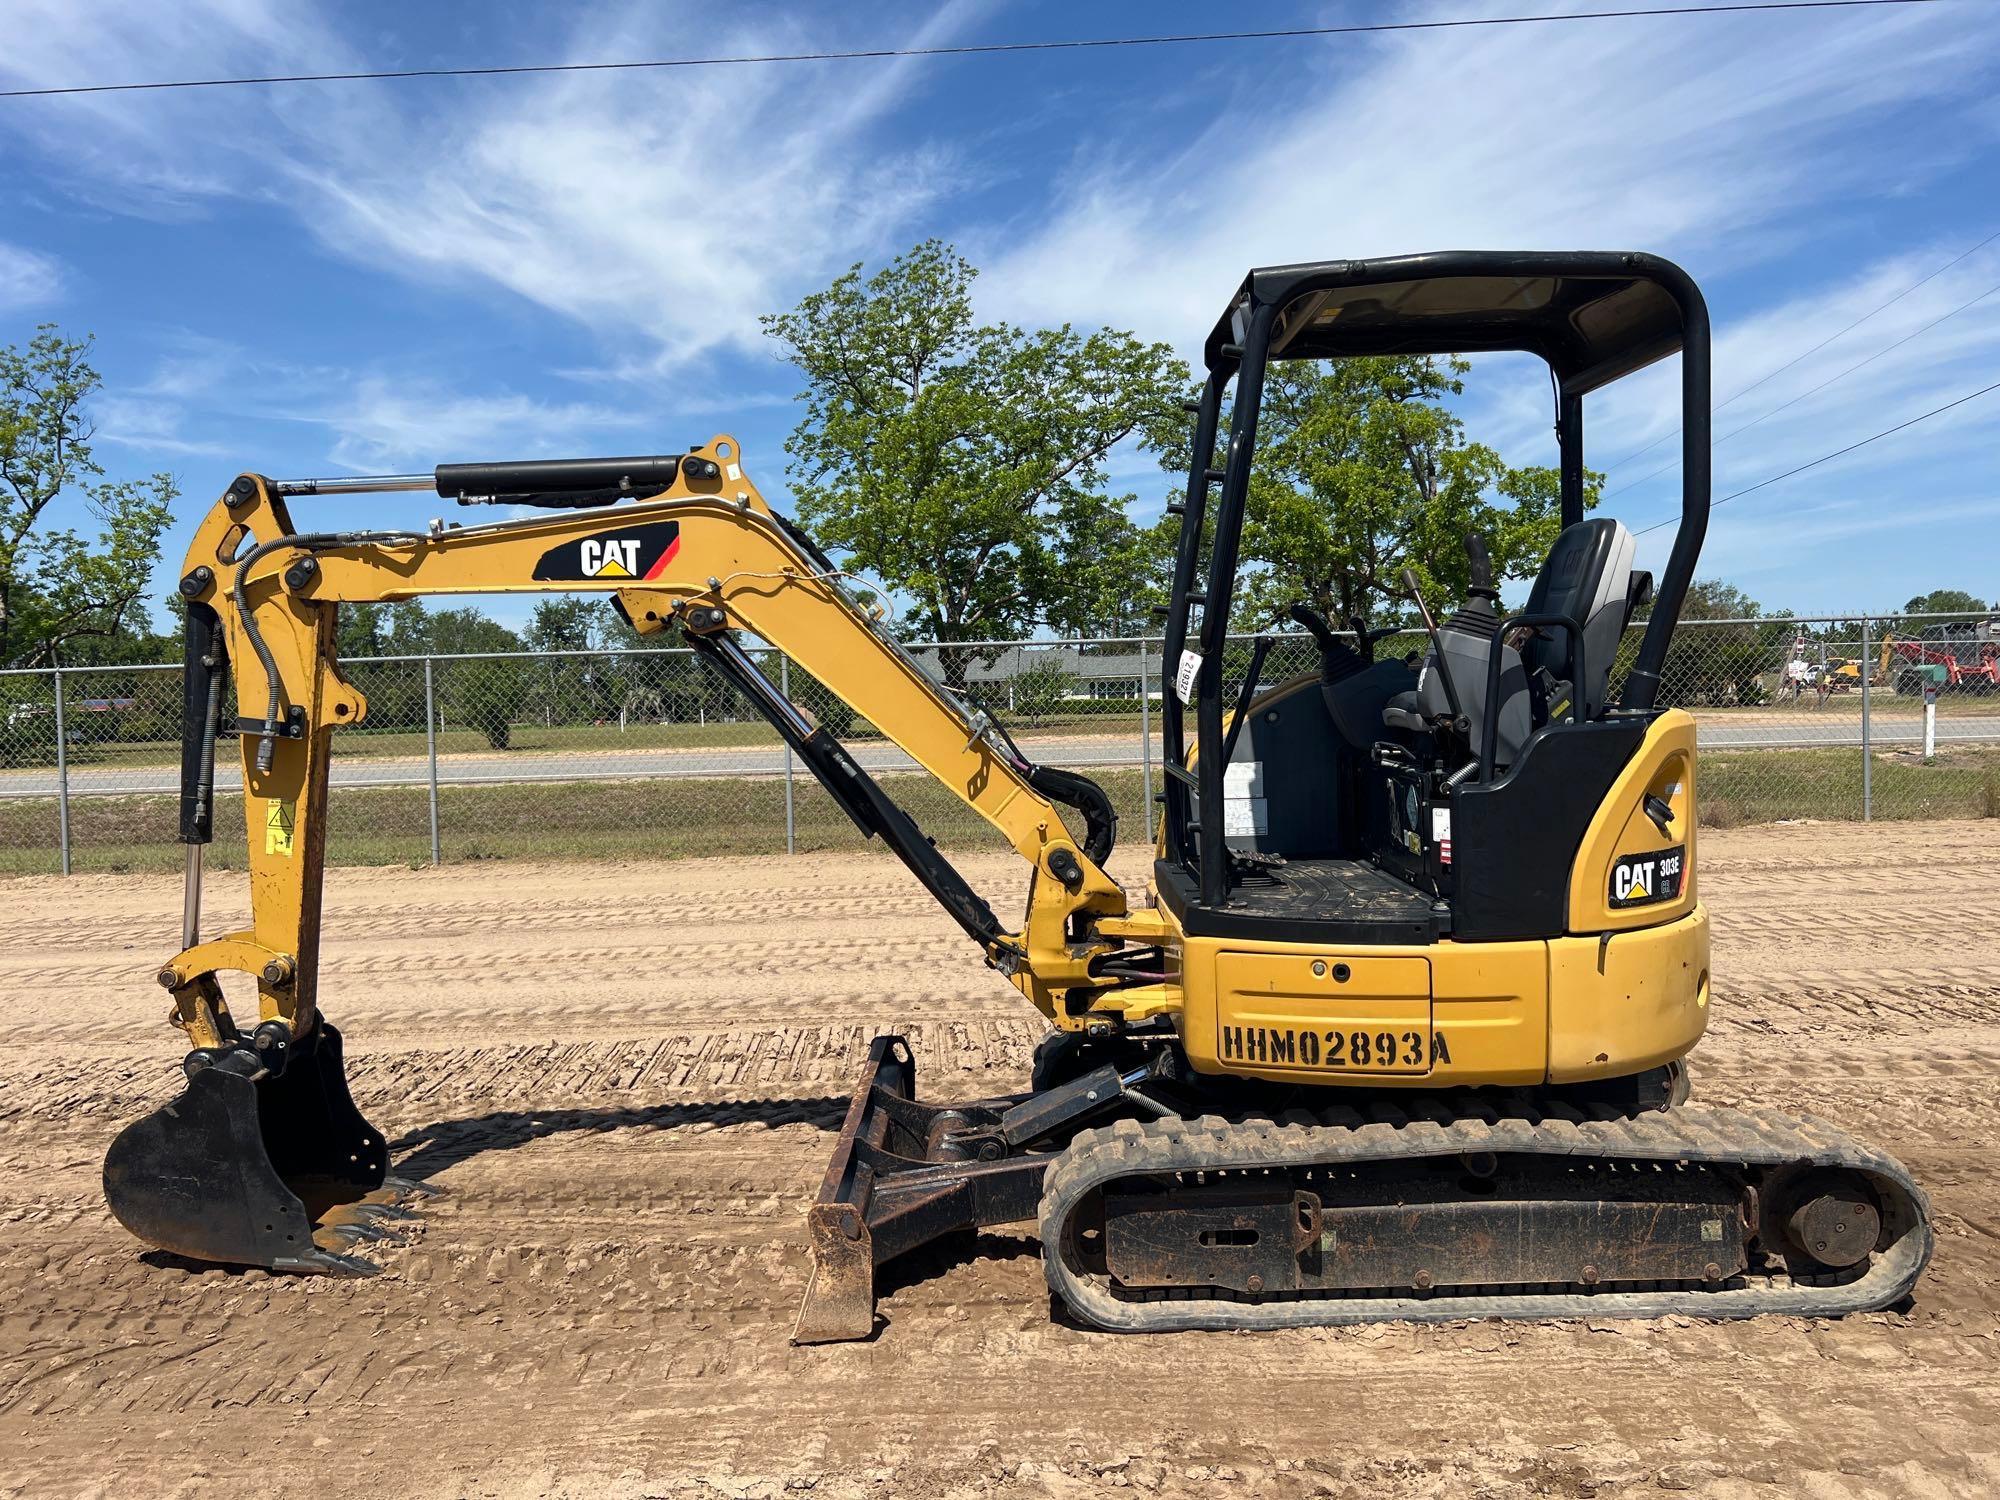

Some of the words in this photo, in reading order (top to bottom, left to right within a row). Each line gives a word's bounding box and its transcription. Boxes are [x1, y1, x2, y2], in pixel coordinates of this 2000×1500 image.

[581, 539, 641, 577] CAT
[1180, 662, 1194, 696] 219321
[1615, 861, 1655, 900] CAT
[1660, 856, 1680, 877] 303E
[1223, 1025, 1452, 1067] HHM02893A
